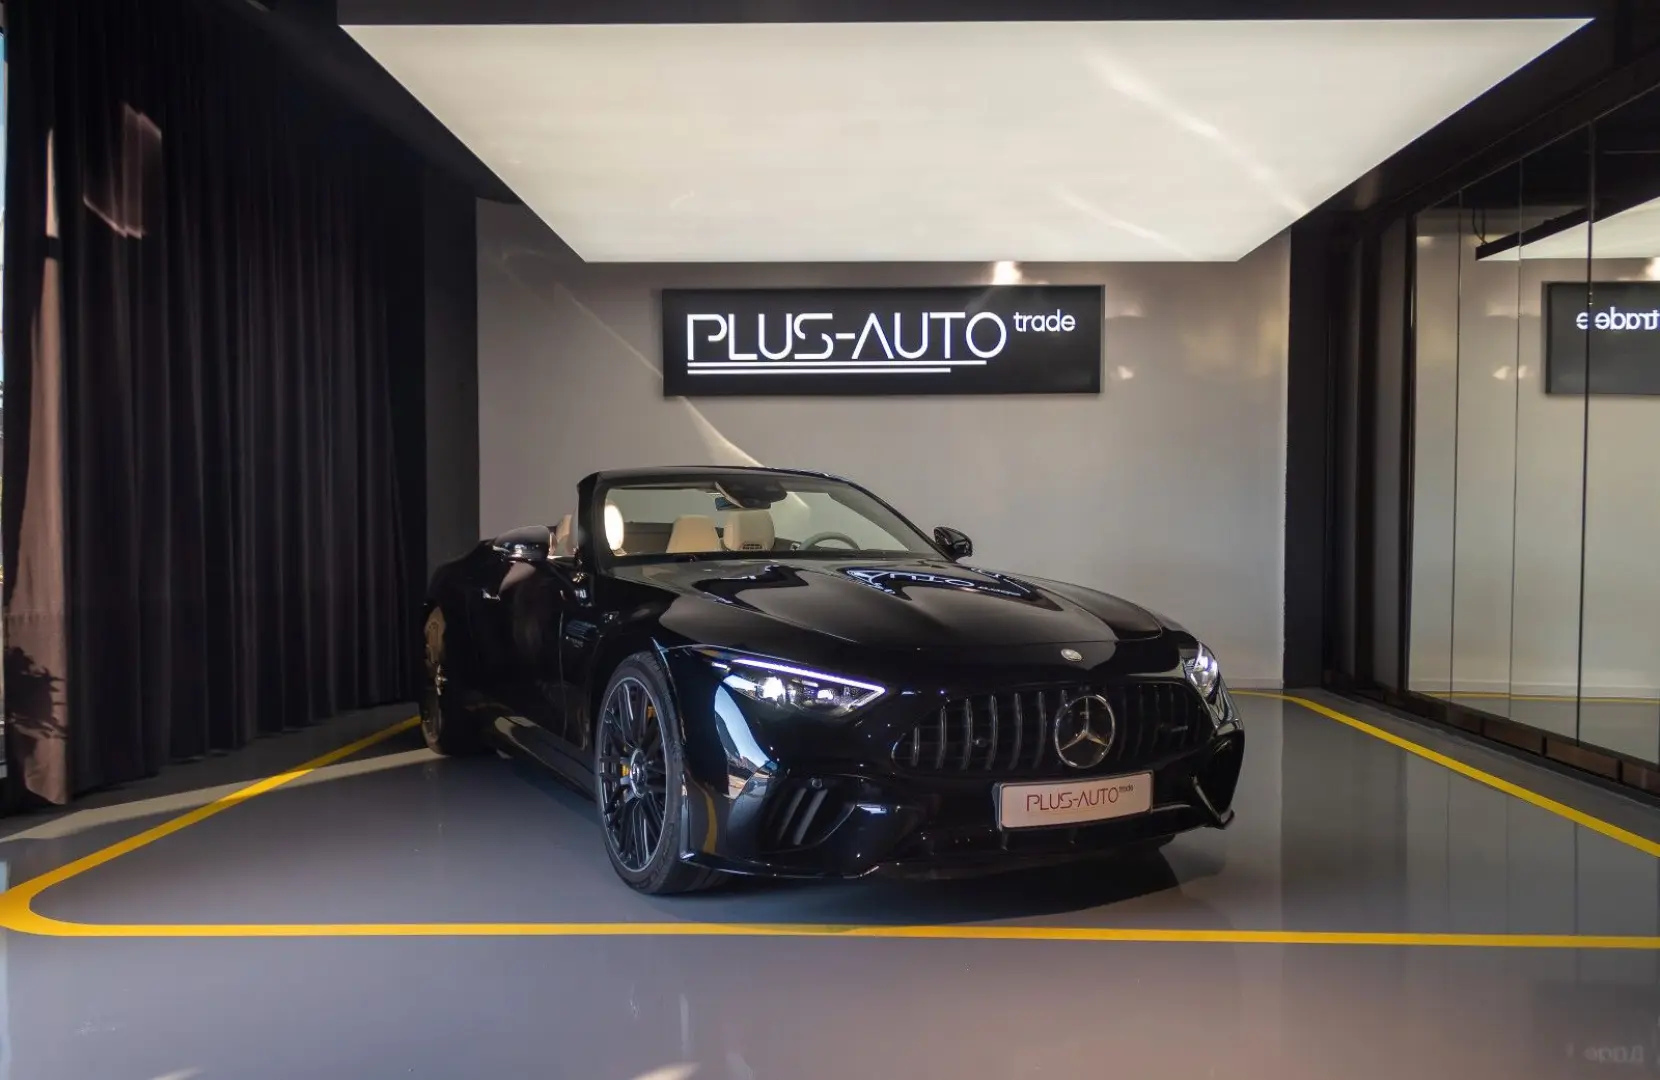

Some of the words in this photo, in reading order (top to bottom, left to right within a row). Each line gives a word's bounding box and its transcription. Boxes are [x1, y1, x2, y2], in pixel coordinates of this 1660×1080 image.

[687, 312, 1007, 361] PLUS-AUTO
[1013, 309, 1076, 332] trade
[1026, 787, 1119, 812] PLUS-AUTO
